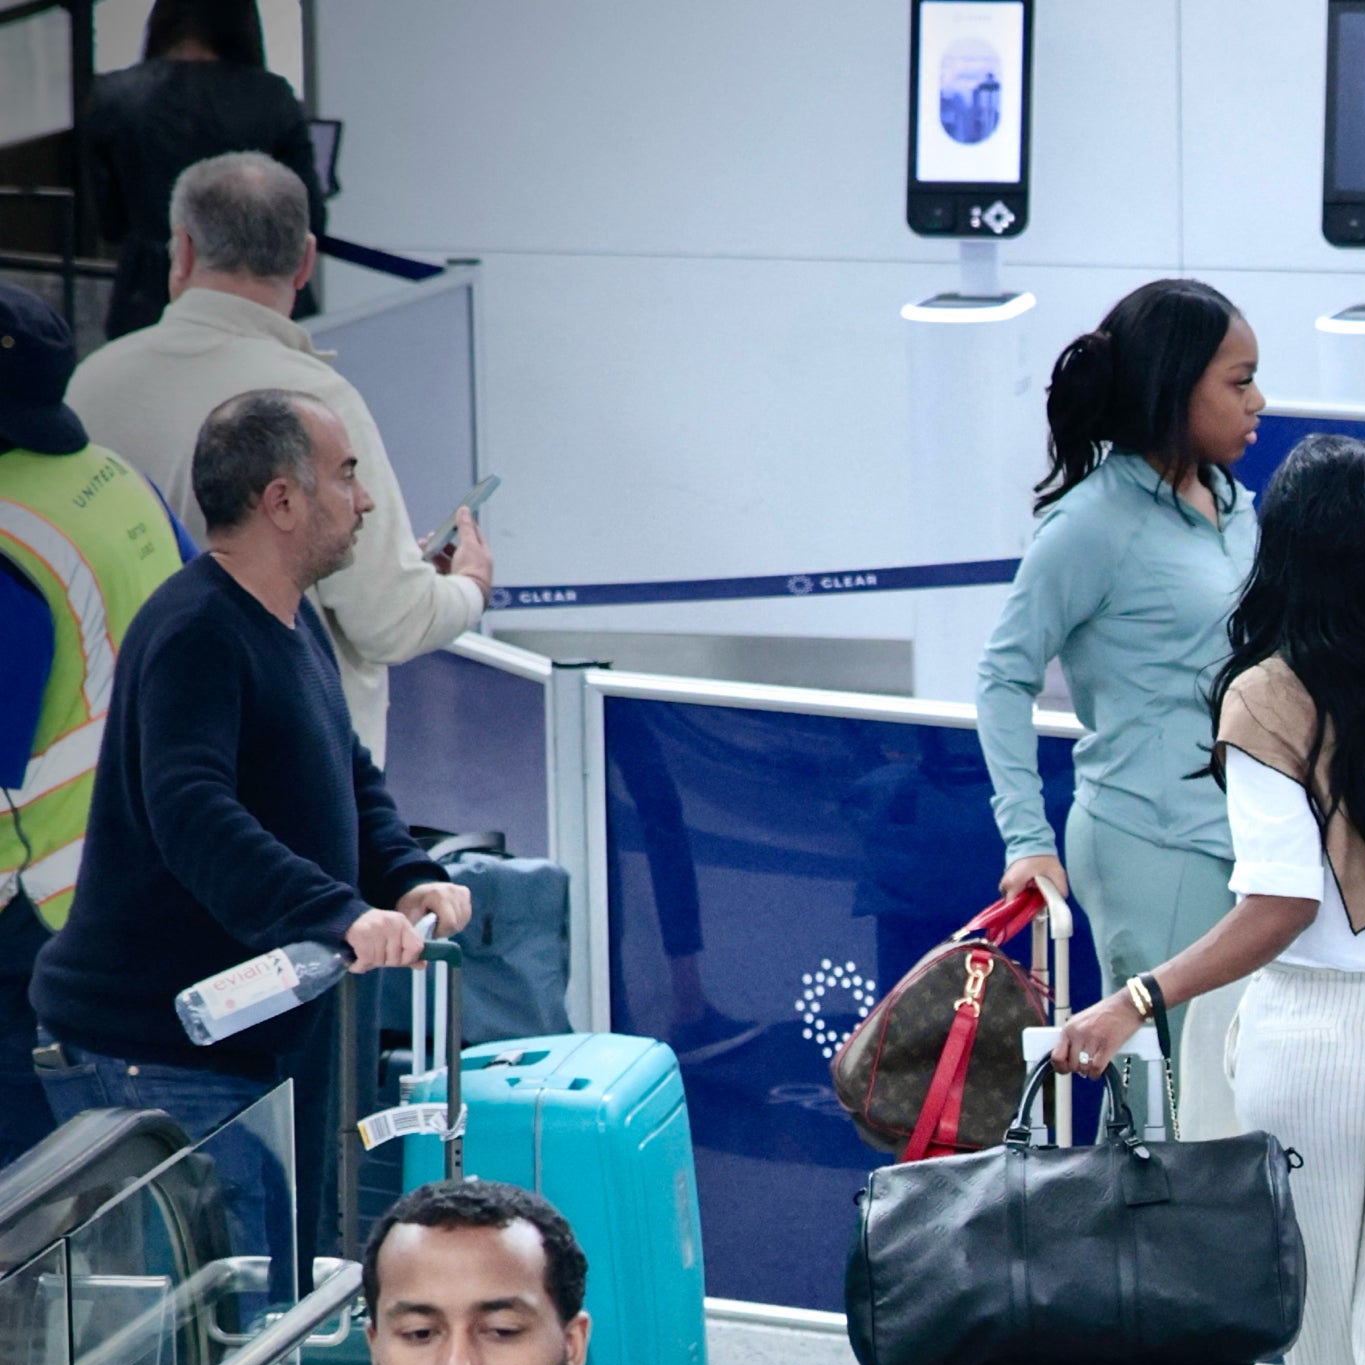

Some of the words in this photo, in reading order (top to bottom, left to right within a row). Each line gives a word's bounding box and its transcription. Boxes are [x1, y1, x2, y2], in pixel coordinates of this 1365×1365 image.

[72, 464, 115, 508] UNITED
[820, 573, 877, 590] CLEAR
[518, 590, 577, 604] CLEAR
[213, 960, 271, 991] evian
